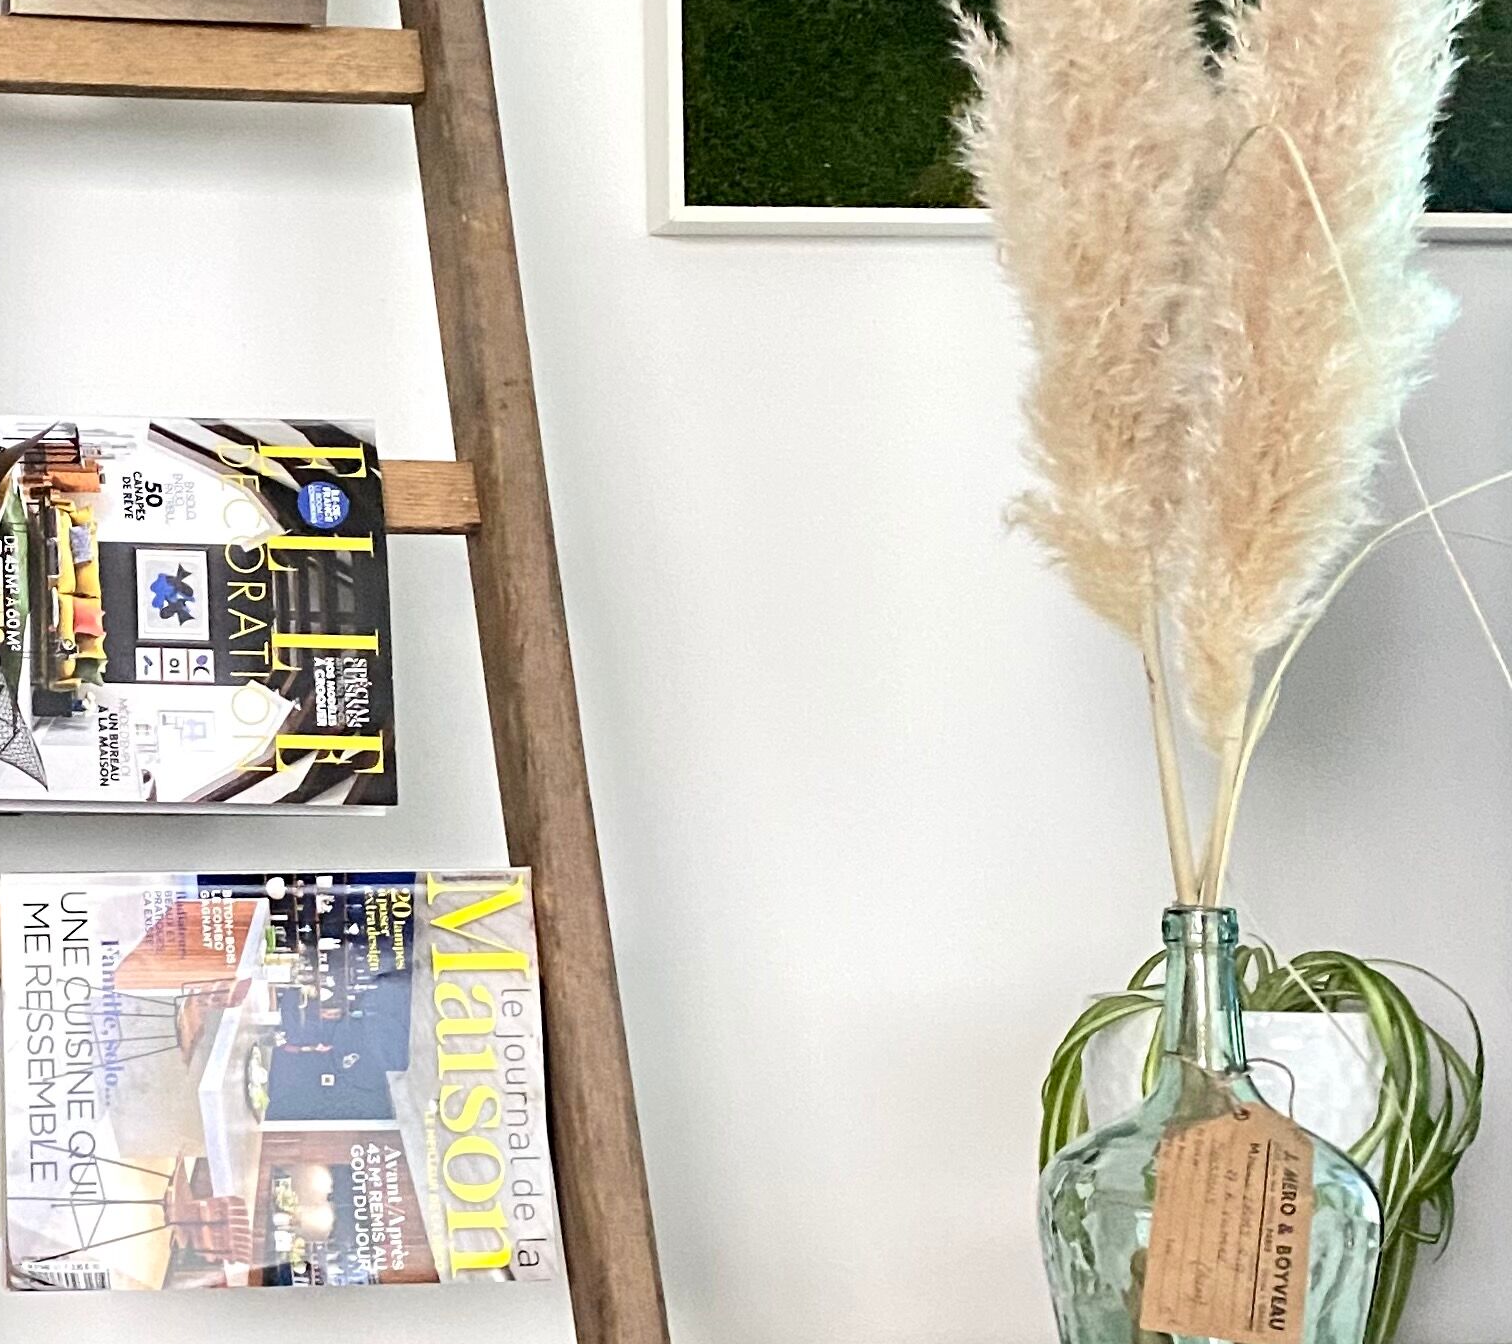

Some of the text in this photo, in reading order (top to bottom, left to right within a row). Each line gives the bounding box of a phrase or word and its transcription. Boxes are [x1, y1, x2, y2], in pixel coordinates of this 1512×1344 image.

[122, 476, 133, 490] DE
[144, 480, 163, 508] 50
[3, 535, 17, 554] DE
[4, 555, 19, 573] 45
[5, 608, 21, 629] 60
[258, 442, 385, 774] ELLE
[98, 717, 109, 733] LA
[108, 712, 121, 782] UN BUREAU
[98, 736, 110, 787] MAISON
[199, 889, 213, 949] GAGNANT
[212, 906, 225, 951] COMBO
[390, 887, 413, 971] 20 lampes
[366, 926, 382, 972] design
[23, 903, 58, 1183] ME RESSEMBLE
[61, 891, 97, 1196] UNE CUISINE QUI
[428, 871, 534, 1279] Maison
[496, 988, 548, 1267] le journal de la
[353, 1195, 369, 1220] DU
[369, 1191, 386, 1242] REMIS
[354, 1222, 373, 1272] JOUR
[1268, 1244, 1293, 1332] BOYVEAU
